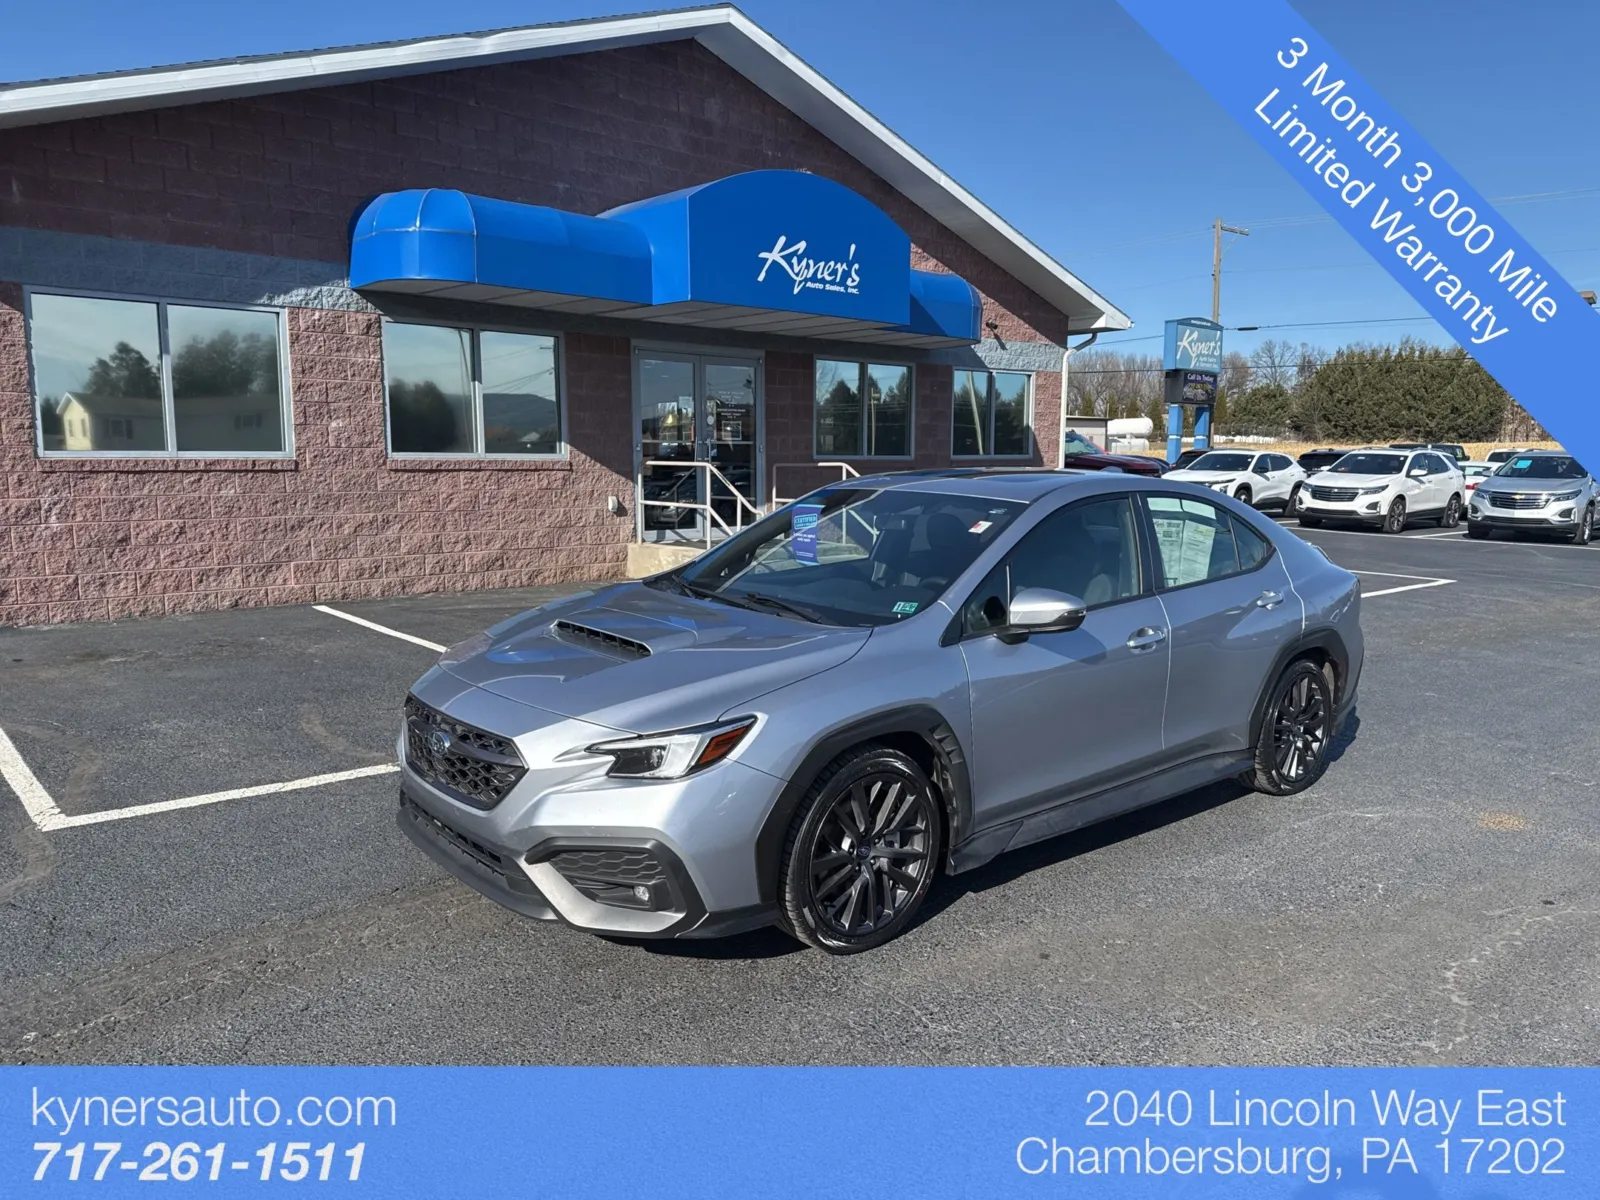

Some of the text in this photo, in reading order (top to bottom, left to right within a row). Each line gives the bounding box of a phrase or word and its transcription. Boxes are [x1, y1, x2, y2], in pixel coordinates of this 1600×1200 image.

[757, 235, 860, 295] Kyner's
[805, 281, 824, 290] Auto
[824, 283, 846, 293] Sales,
[1176, 329, 1221, 368] Kyner's
[1202, 374, 1214, 383] Today
